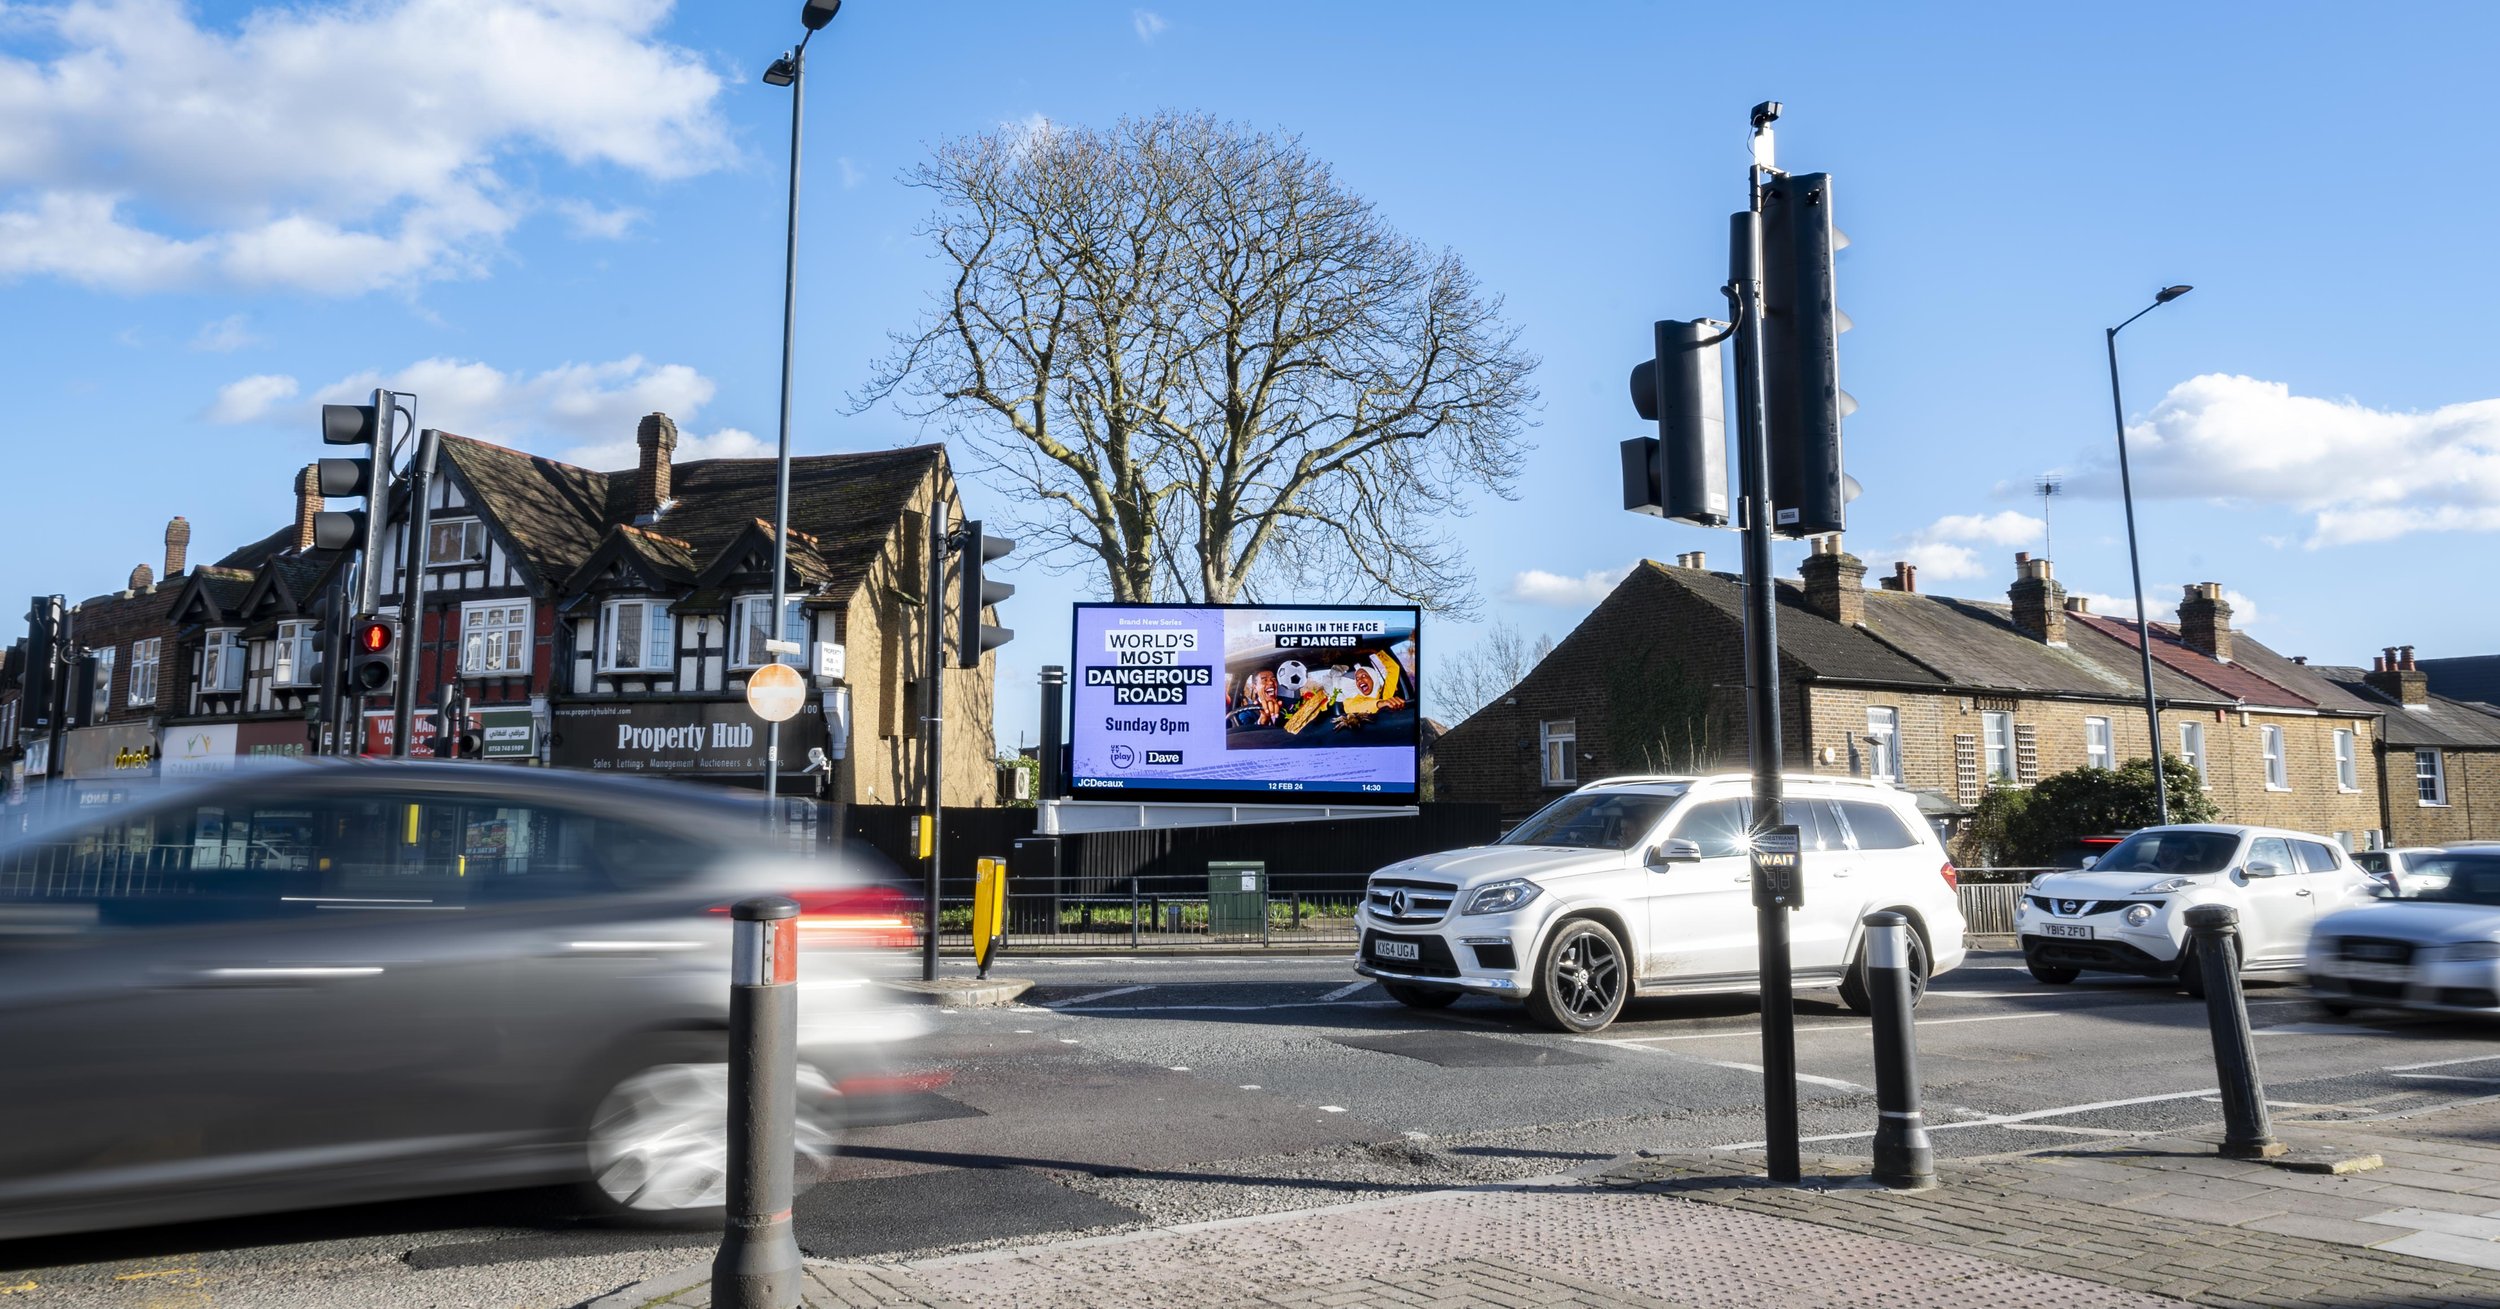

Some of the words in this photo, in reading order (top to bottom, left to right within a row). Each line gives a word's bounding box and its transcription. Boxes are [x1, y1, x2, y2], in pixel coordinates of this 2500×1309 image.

[1119, 618, 1141, 626] Brand
[1142, 618, 1159, 626] New
[1160, 618, 1182, 626] Series
[1258, 622, 1312, 632] LAUGHING
[1315, 622, 1327, 632] IN
[1329, 622, 1349, 632] THE
[1352, 622, 1379, 632] FACE
[1109, 633, 1194, 648] WORLD'S
[1280, 636, 1298, 647] OF
[1301, 636, 1357, 647] DANGER
[1120, 650, 1176, 665] MOST
[1088, 668, 1209, 685] DANGEROUS
[1117, 687, 1184, 703] ROADS
[1105, 716, 1158, 735] Sunday
[1160, 717, 1190, 735] 8pm
[617, 722, 706, 752] Property
[711, 722, 754, 748] Hub
[593, 758, 611, 769] Sales
[616, 758, 645, 770] Lettings
[649, 758, 694, 770] Management
[700, 757, 741, 768] Auctioneers
[746, 758, 752, 768] &
[1113, 752, 1132, 762] play
[1147, 751, 1180, 763] Dave
[1077, 778, 1124, 788] JCDecaux
[1268, 782, 1277, 790] 12
[1278, 782, 1294, 790] FEB
[1294, 782, 1304, 790] 24
[1361, 783, 1381, 792] 14:30
[1759, 854, 1795, 866] WAIT
[2045, 925, 2065, 936] YB15
[1377, 942, 1395, 956] KX64
[1397, 944, 1416, 958] UGA
